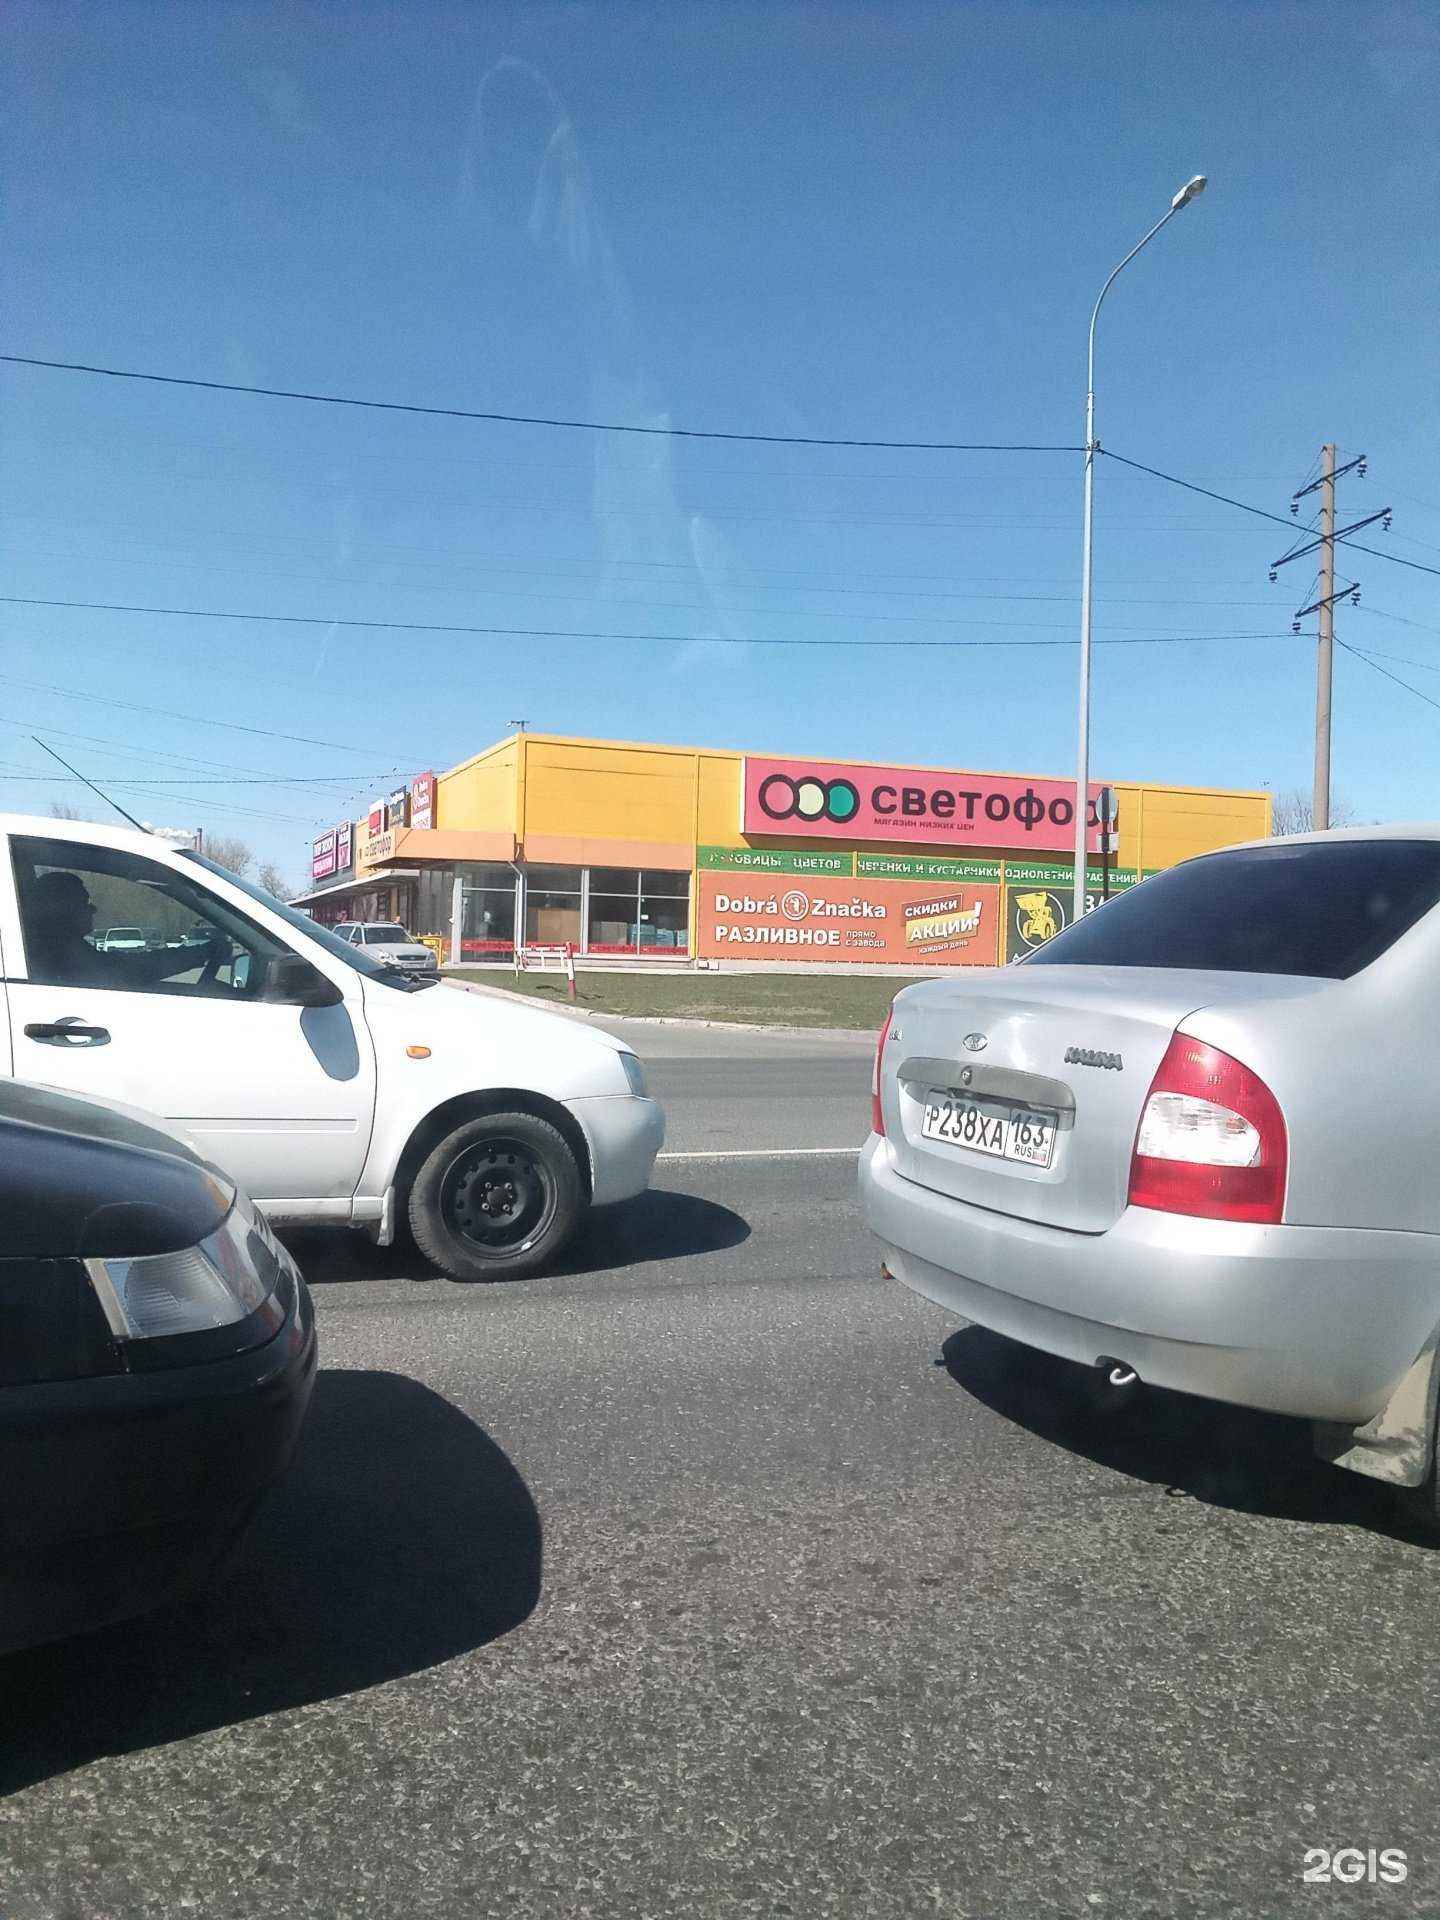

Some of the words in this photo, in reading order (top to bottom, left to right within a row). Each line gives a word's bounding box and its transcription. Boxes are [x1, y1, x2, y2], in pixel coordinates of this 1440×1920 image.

[957, 823, 975, 831] ЦЕН
[1006, 868, 1073, 881] ОДНОЛЕТНИ
[714, 894, 778, 914] Dobrá
[811, 897, 887, 918] Značka
[909, 901, 982, 942] АКЦИИ!
[714, 925, 840, 946] РАЗЛИВНОЕ
[846, 931, 877, 941] прямо
[853, 939, 886, 948] завода
[928, 1100, 1003, 1150] Р238ХА
[1013, 1112, 1046, 1147] 163
[1014, 1143, 1033, 1159] RUS
